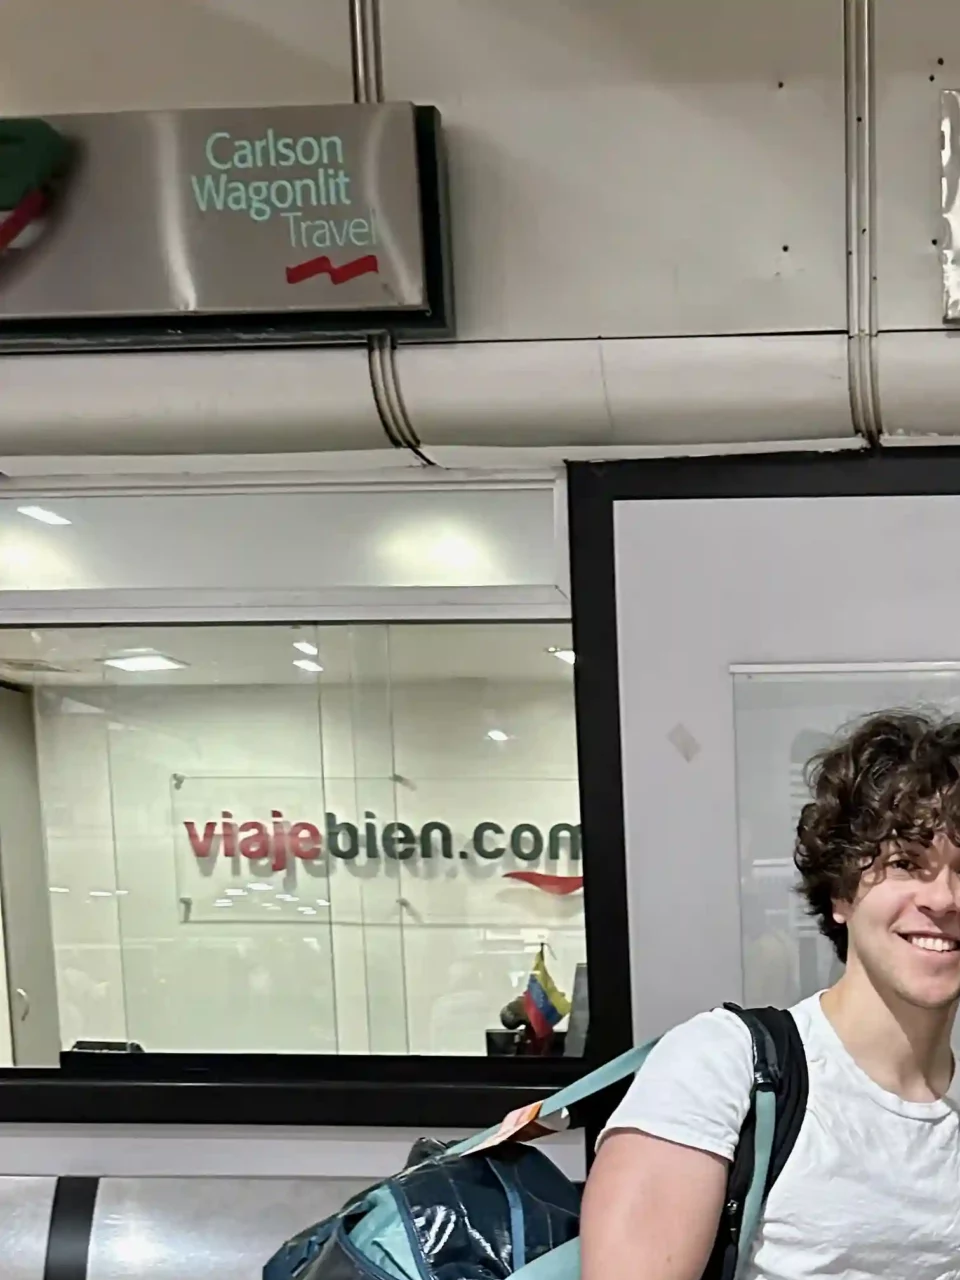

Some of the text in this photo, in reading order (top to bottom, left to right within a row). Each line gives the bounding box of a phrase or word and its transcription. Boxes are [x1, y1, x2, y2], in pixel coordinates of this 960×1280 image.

[206, 128, 344, 170] Carlson
[191, 168, 352, 222] Wagonlit
[281, 207, 377, 249] Travel
